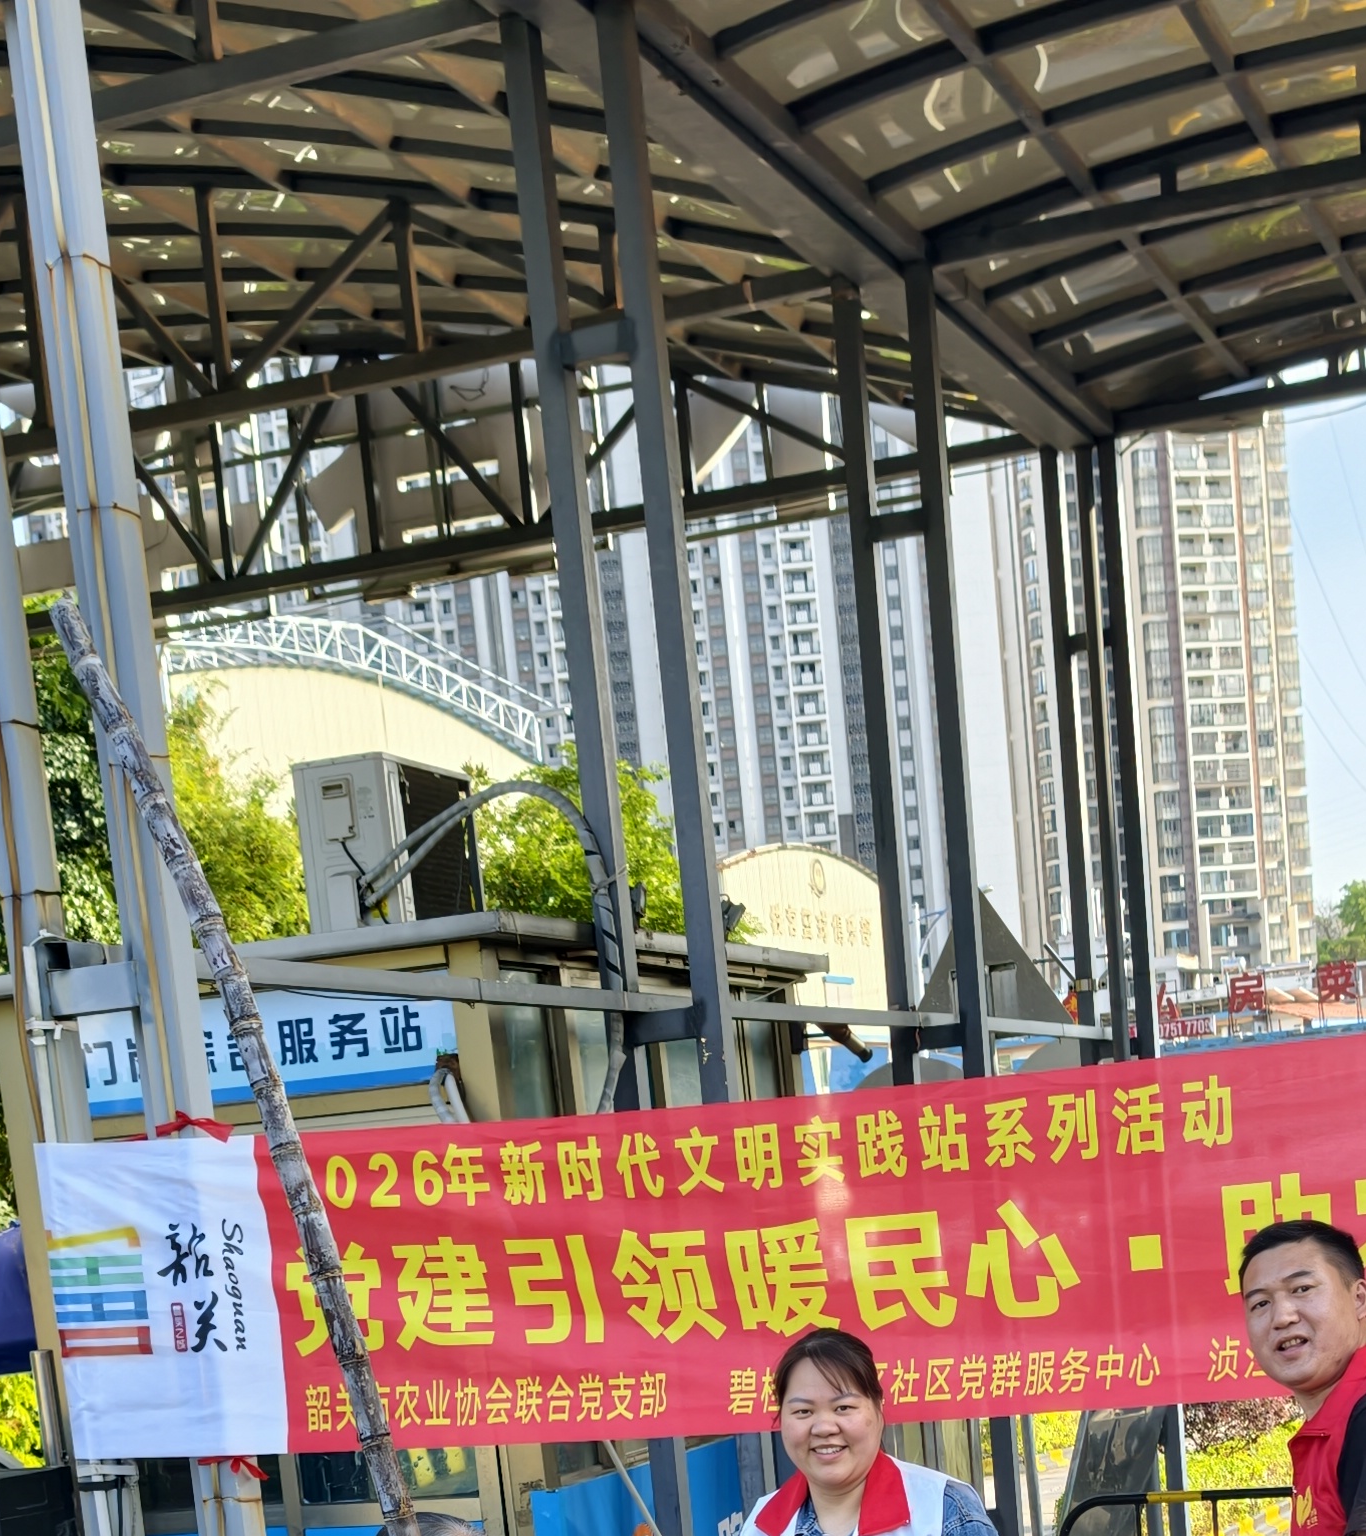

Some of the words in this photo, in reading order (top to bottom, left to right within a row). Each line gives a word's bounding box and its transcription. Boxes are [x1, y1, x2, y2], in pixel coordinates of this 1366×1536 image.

[326, 1075, 1233, 1208] 026年新时代文明实践站系列活动
[222, 1218, 248, 1352] Shaoguan
